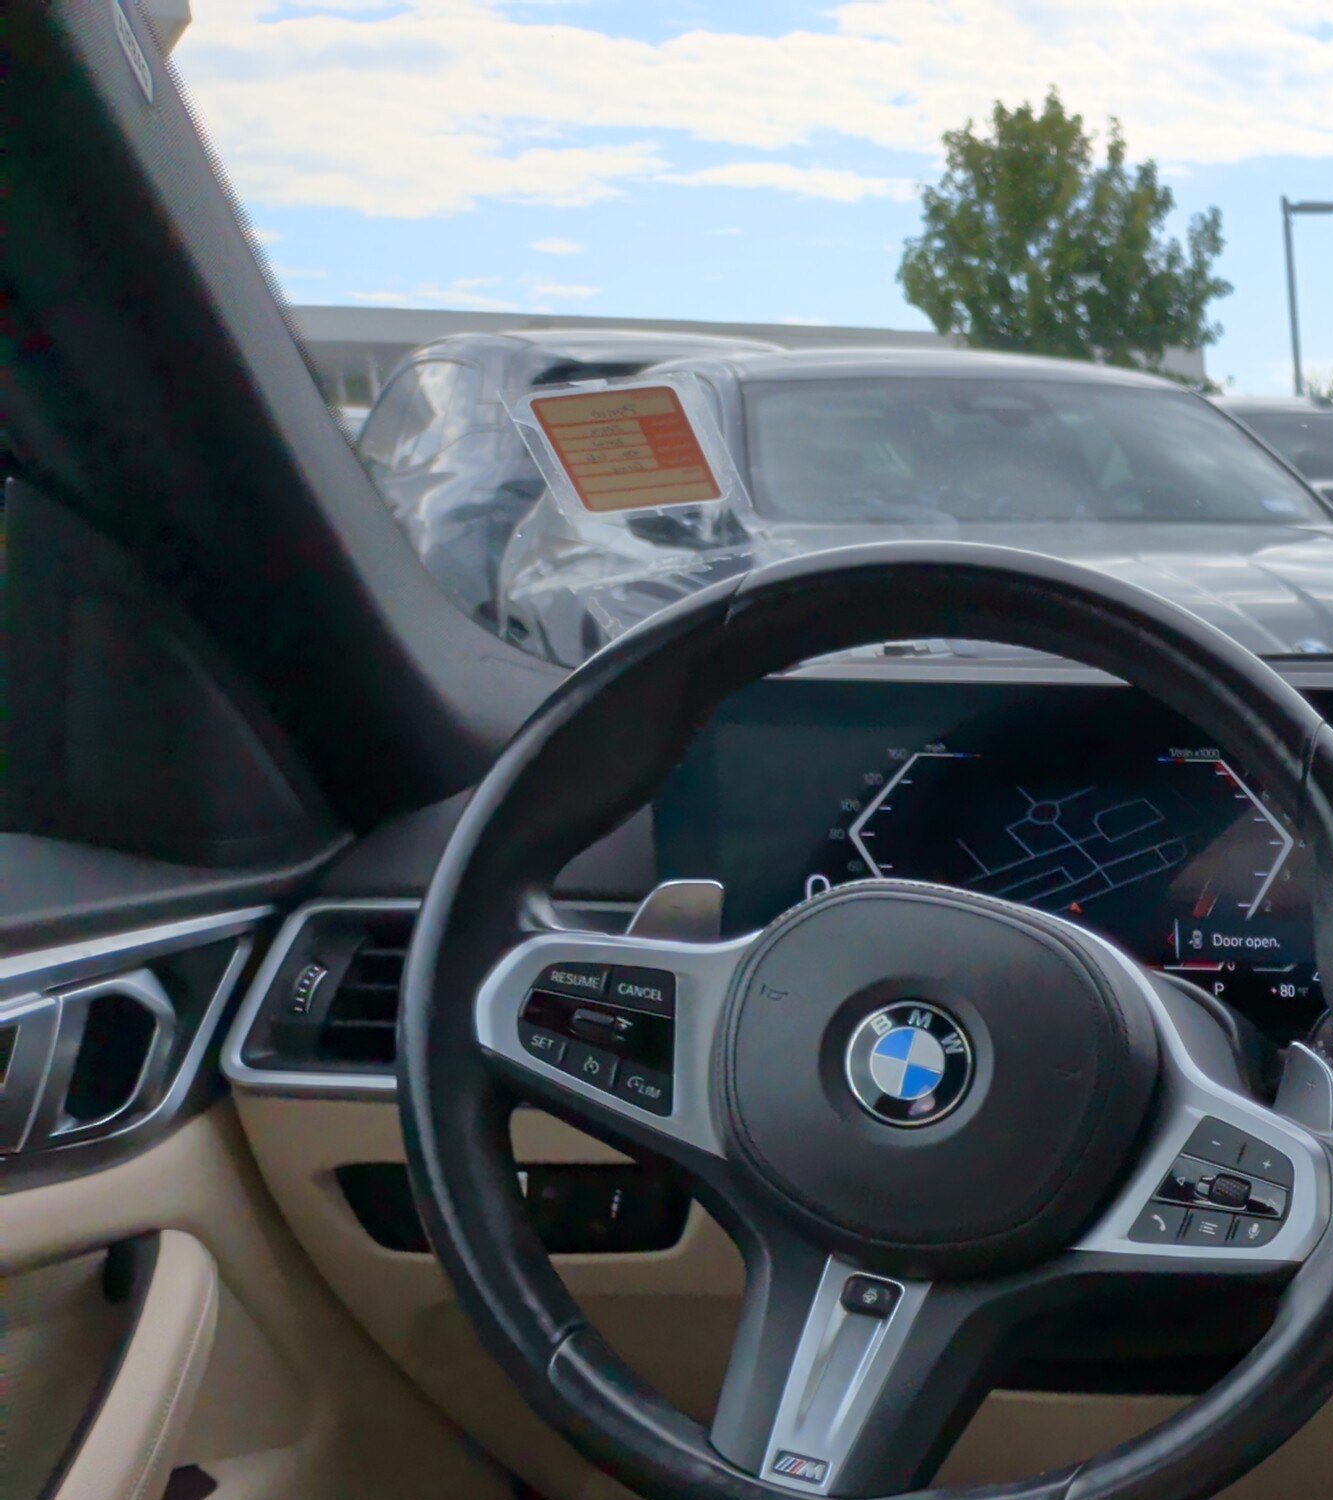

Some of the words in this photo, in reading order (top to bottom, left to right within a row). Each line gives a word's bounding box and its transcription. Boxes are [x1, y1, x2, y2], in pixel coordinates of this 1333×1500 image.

[1213, 933, 1243, 948] Door
[1246, 936, 1281, 950] open.
[550, 971, 600, 990] RESUME
[1214, 983, 1225, 996] P
[617, 982, 663, 1002] CANCEL
[869, 1009, 965, 1055] BMW
[530, 1035, 554, 1049] SET
